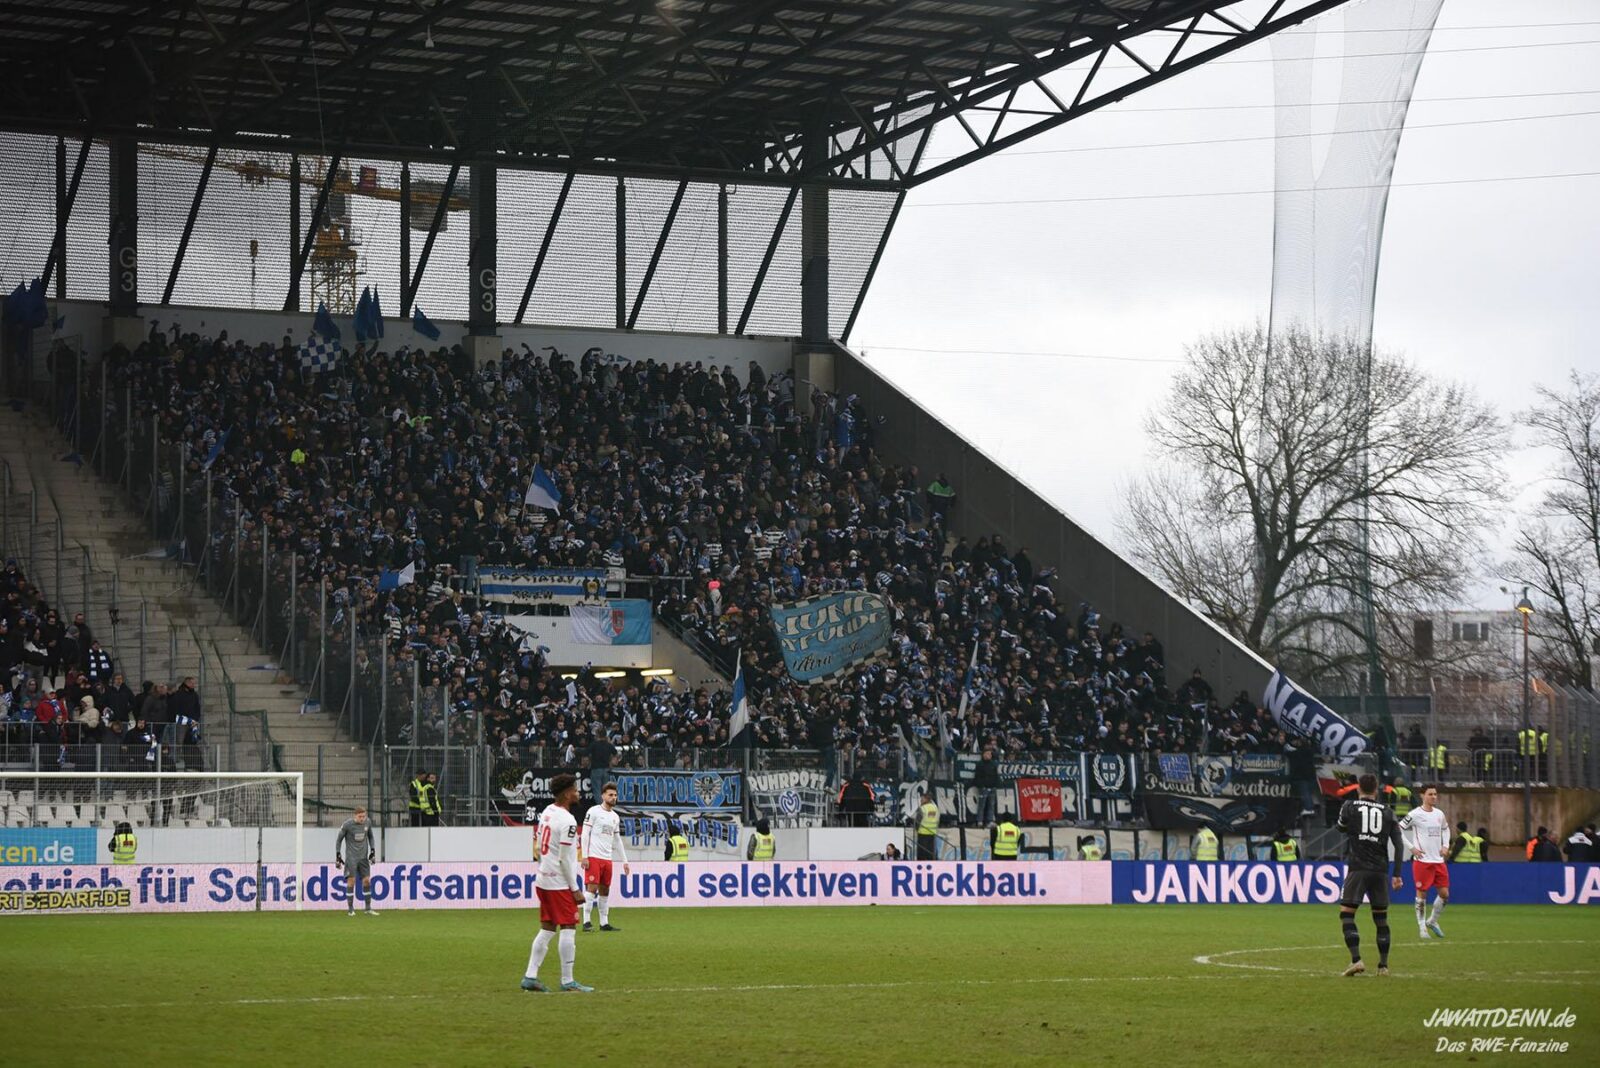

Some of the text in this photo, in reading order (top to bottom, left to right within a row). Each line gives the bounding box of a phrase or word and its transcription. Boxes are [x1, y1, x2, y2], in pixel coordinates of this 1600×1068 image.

[1022, 784, 1060, 797] ULTRAS
[1358, 805, 1383, 835] 10
[137, 867, 195, 904] für
[208, 864, 600, 908] Schadstoffsanier
[620, 864, 686, 899] und
[698, 864, 879, 898] selektiven
[891, 863, 1047, 898] Rückbau.
[1132, 863, 1371, 904] JANKOWS
[1548, 866, 1600, 904] JA
